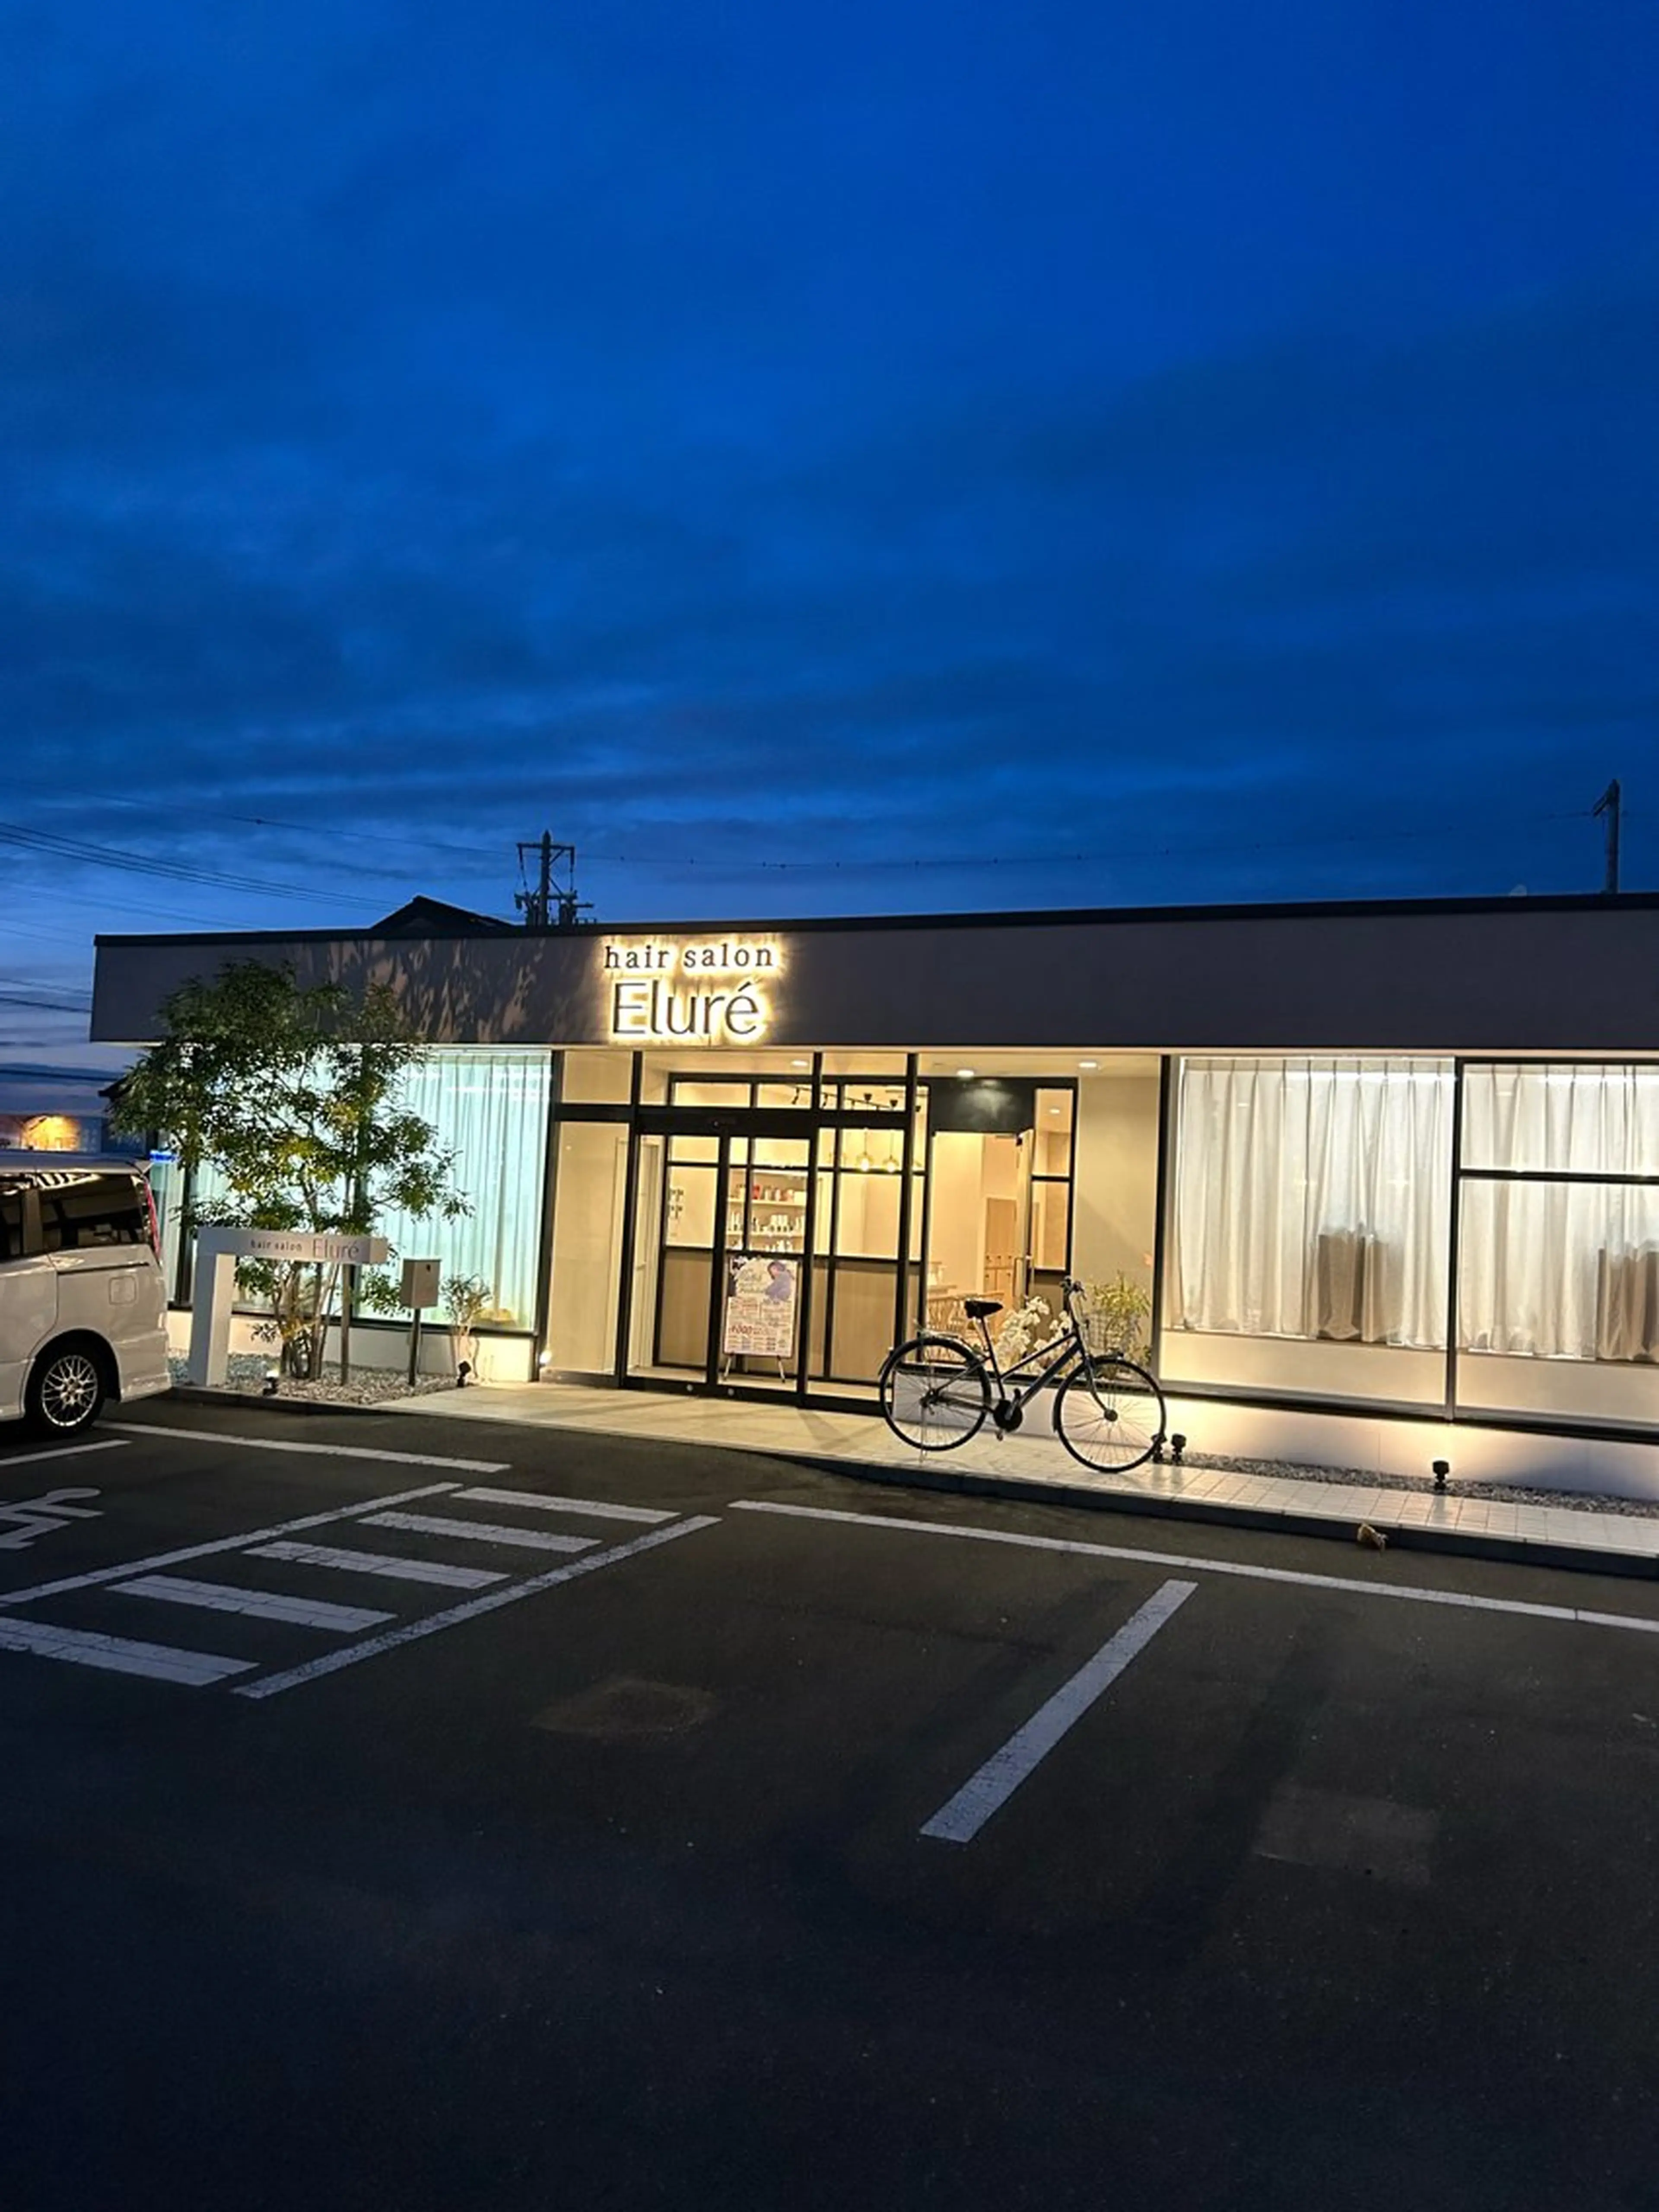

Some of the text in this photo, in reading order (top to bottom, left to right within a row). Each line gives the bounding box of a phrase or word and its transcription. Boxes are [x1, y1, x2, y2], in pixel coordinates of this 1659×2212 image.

[604, 943, 774, 969] hair salon
[613, 979, 759, 1035] Eluré
[251, 1238, 359, 1260] hair salon Eluré
